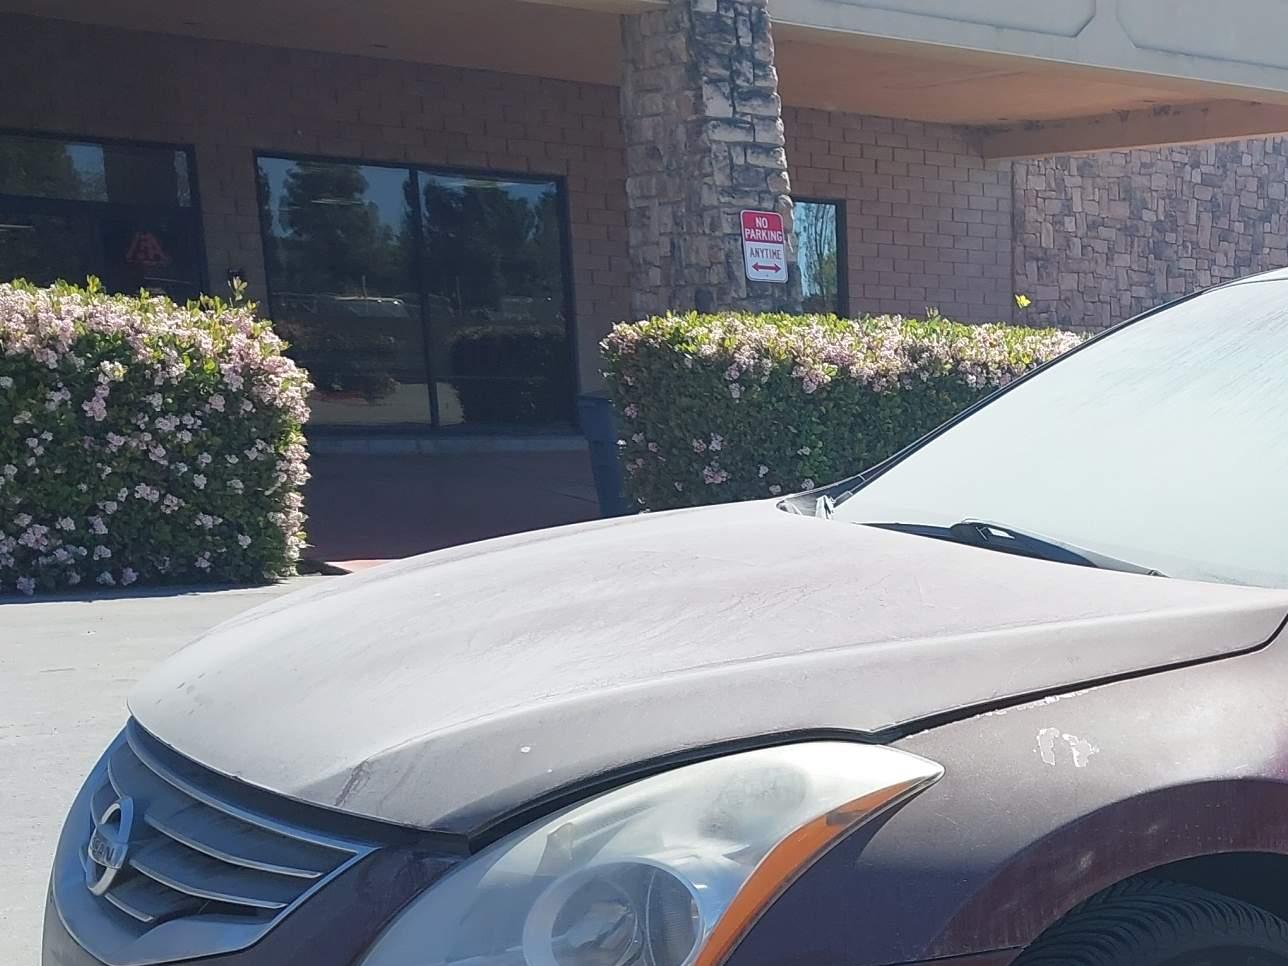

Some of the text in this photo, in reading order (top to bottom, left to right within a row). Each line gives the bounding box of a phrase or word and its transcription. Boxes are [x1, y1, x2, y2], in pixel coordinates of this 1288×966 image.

[756, 217, 768, 228] NO
[745, 228, 783, 242] PARKING
[750, 248, 782, 259] ANYTIME
